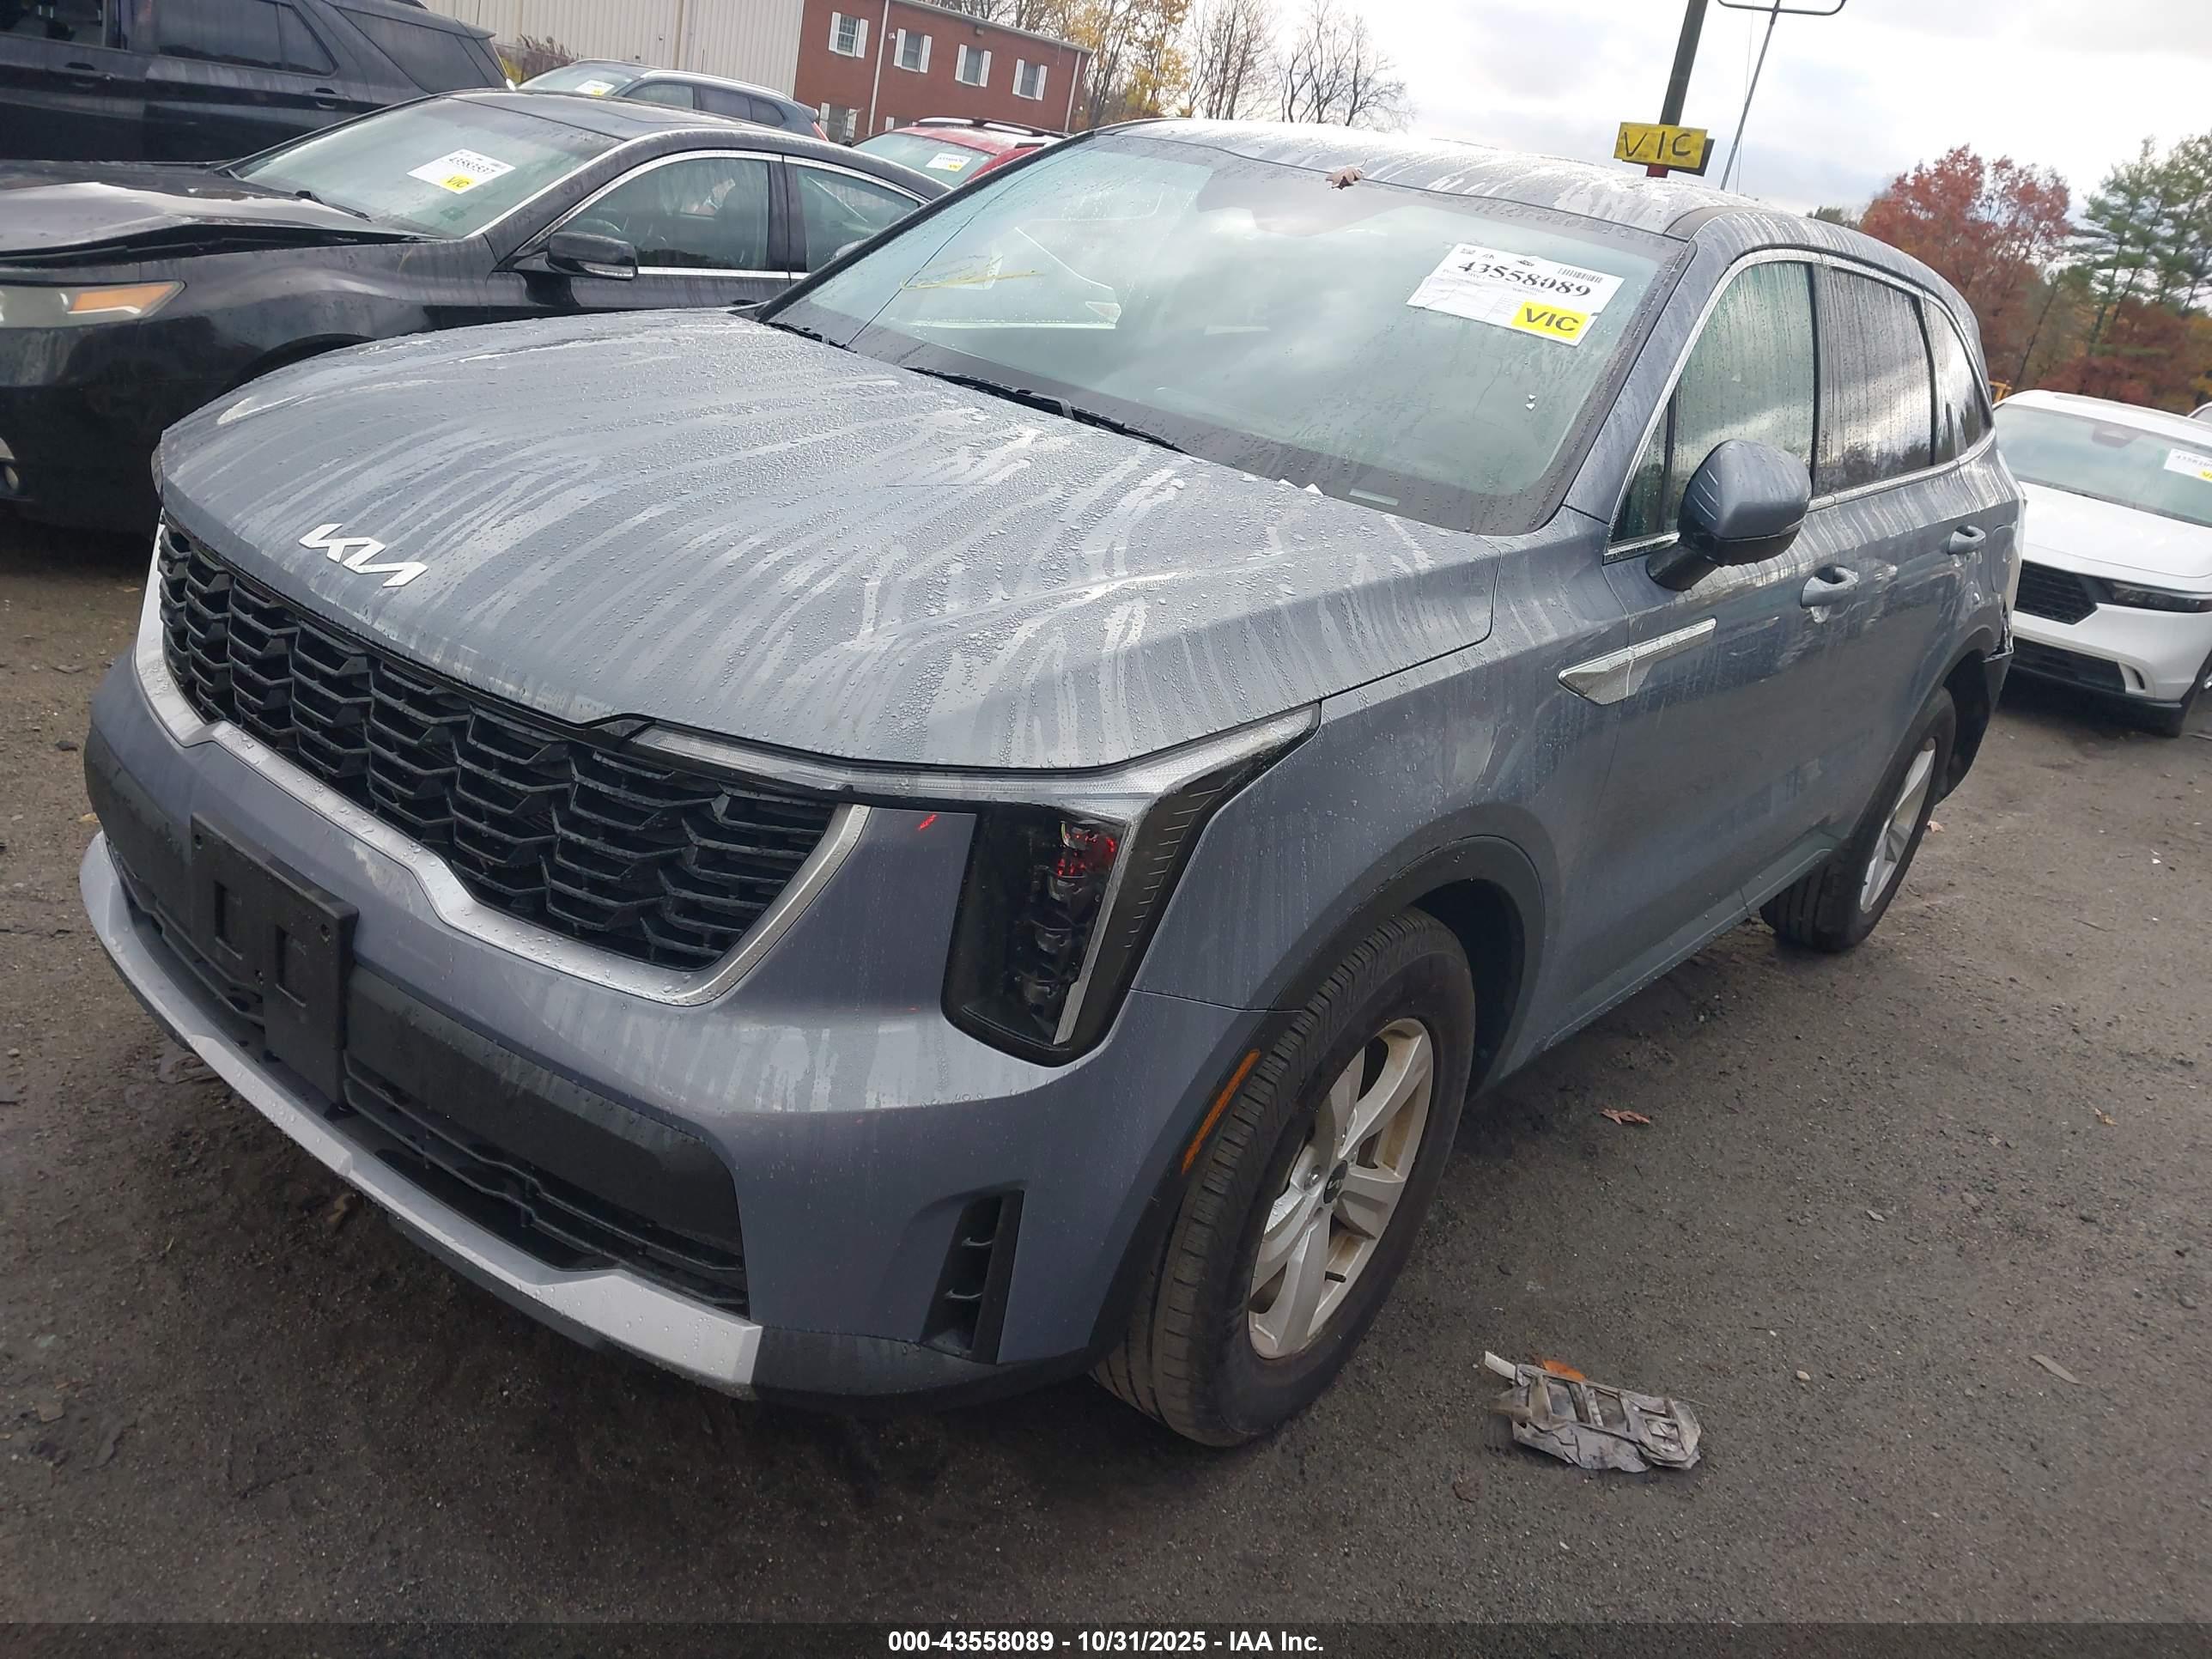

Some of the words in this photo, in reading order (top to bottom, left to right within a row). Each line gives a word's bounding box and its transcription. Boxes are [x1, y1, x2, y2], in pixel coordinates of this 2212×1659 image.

[1623, 131, 1692, 160] VIC
[1457, 261, 1591, 297] 43558089
[1526, 307, 1579, 331] VIC
[299, 523, 428, 588] KIA
